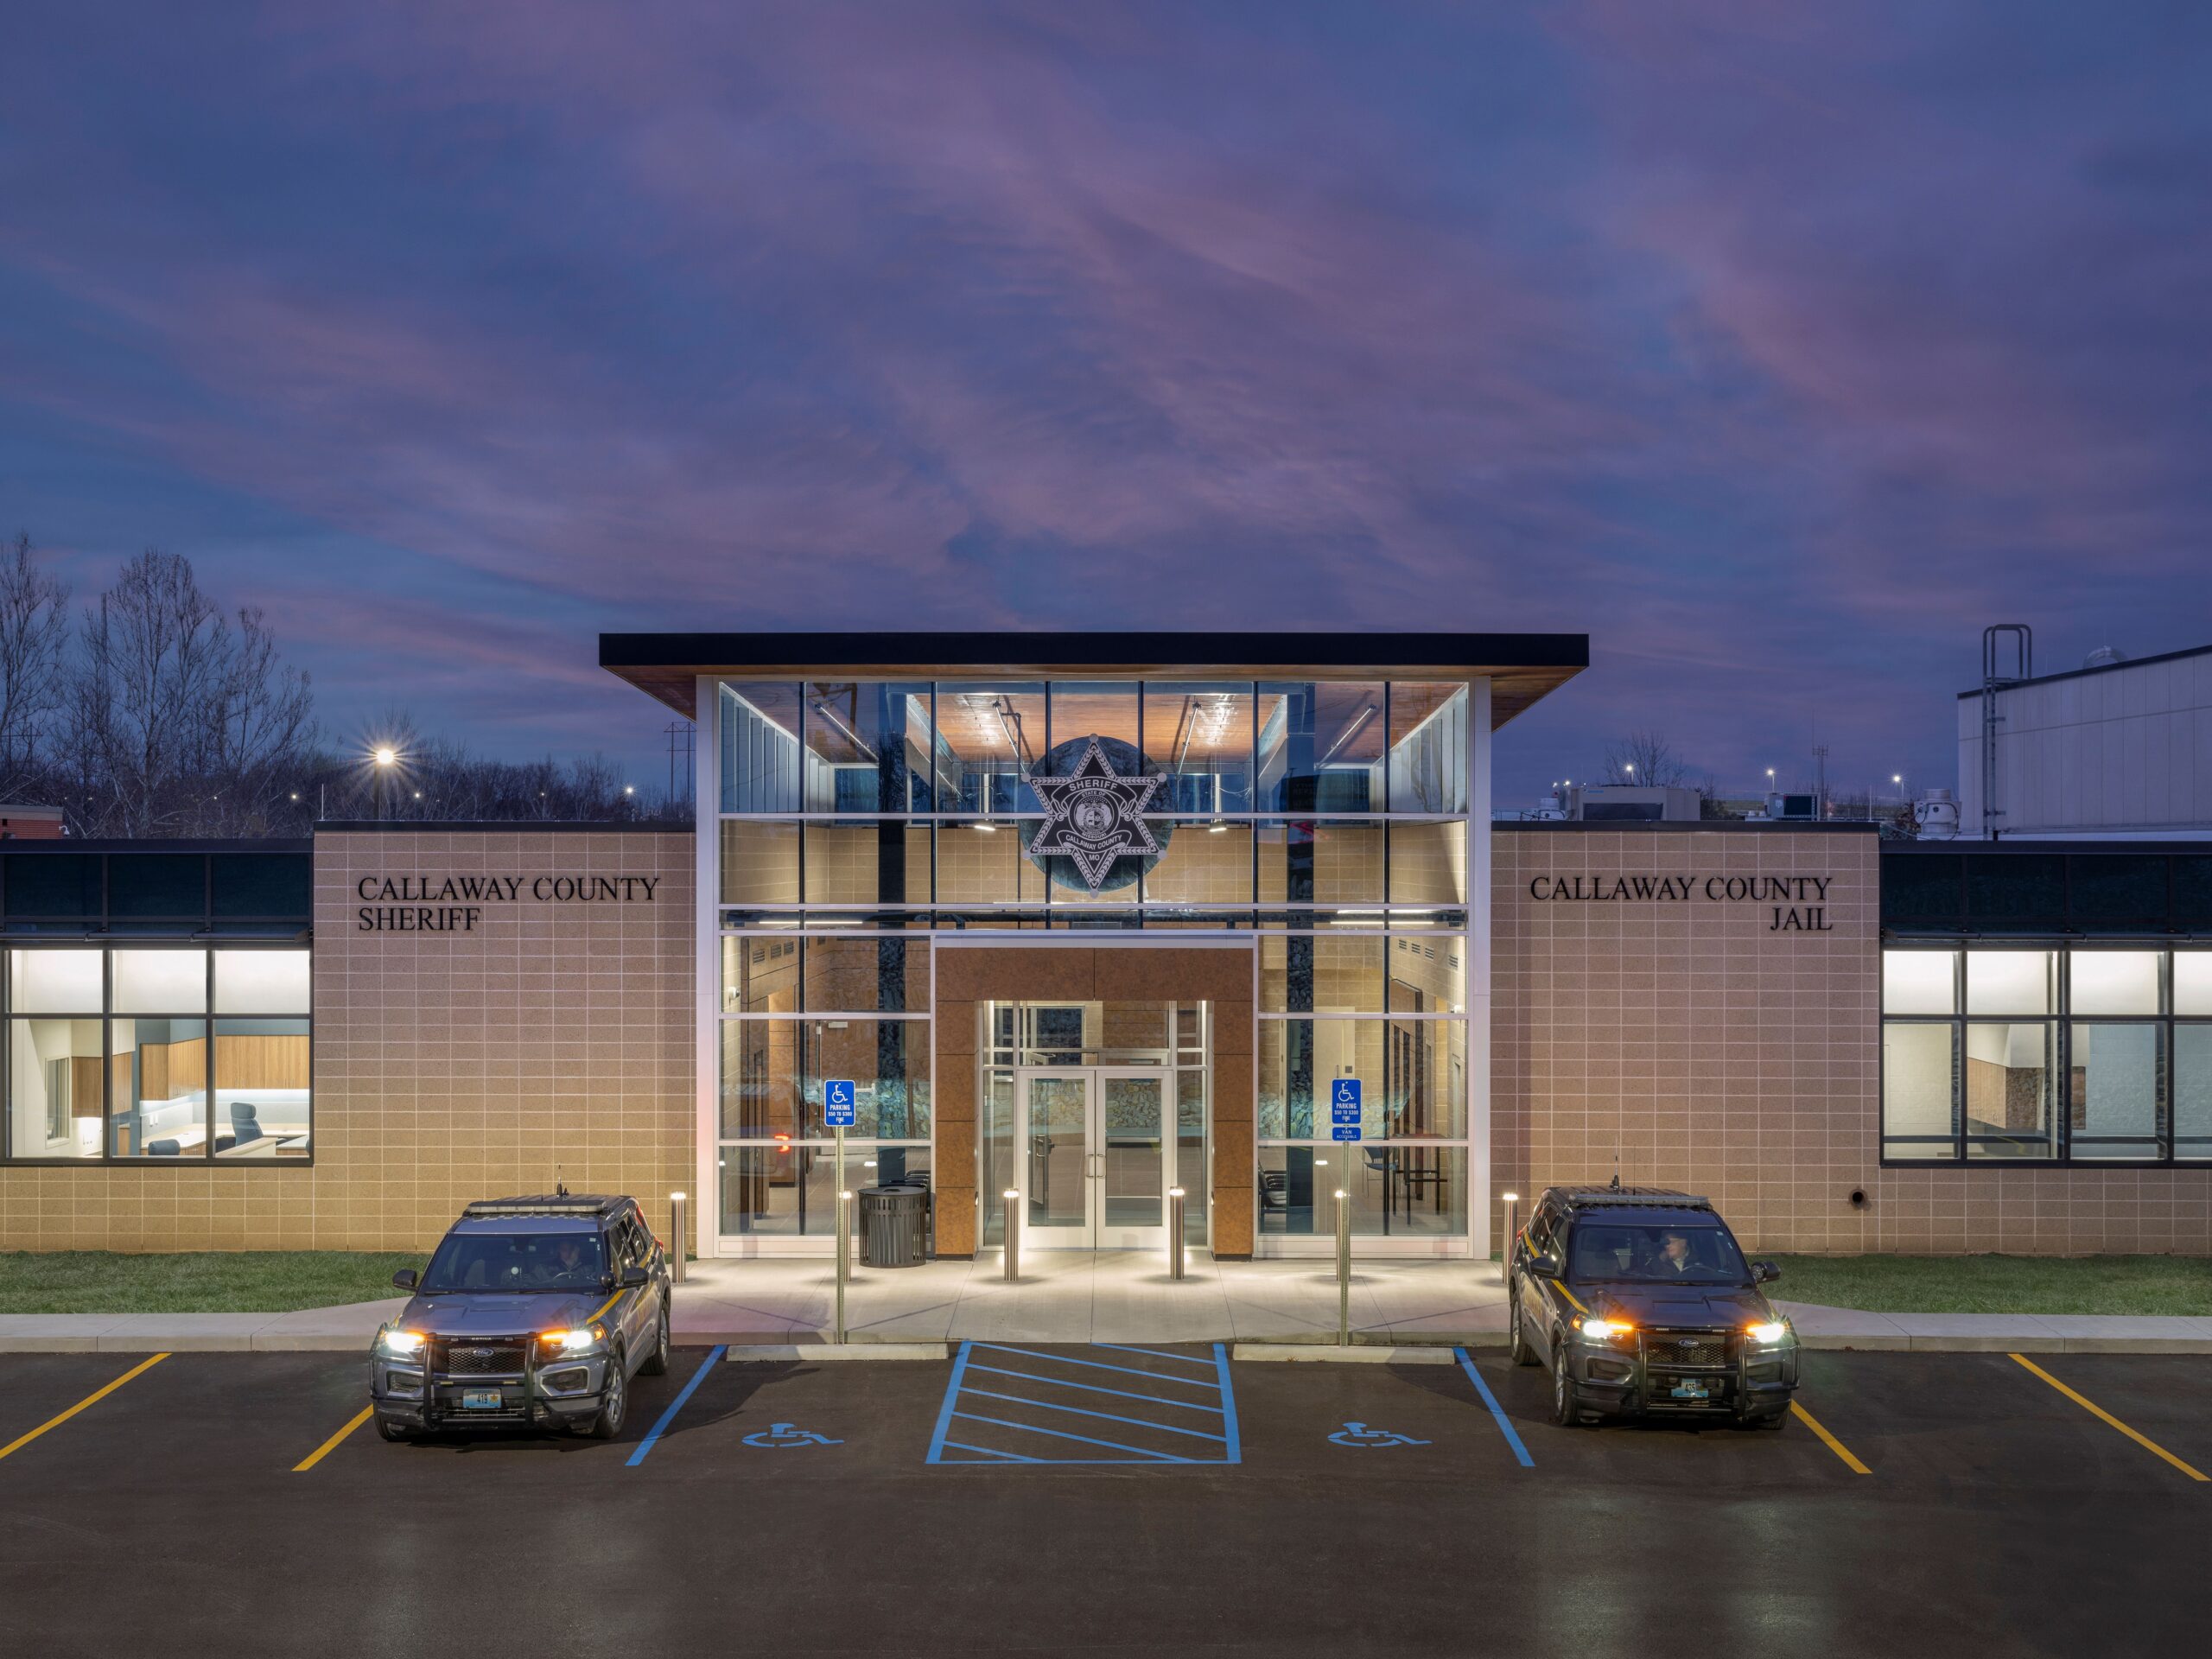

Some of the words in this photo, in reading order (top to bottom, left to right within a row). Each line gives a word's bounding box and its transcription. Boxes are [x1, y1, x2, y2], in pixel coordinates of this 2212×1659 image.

[1069, 779, 1118, 791] SHERIFF
[1065, 834, 1096, 850] CALLAWAY
[1097, 835, 1122, 849] COUNTY
[358, 877, 524, 900] CALLAWAY
[532, 877, 661, 900] COUNTY
[1530, 876, 1696, 900] CALLAWAY
[1705, 876, 1833, 900] COUNTY
[358, 907, 480, 931] SHERIFF
[1770, 907, 1833, 931] JAIL
[477, 1393, 488, 1403] 419
